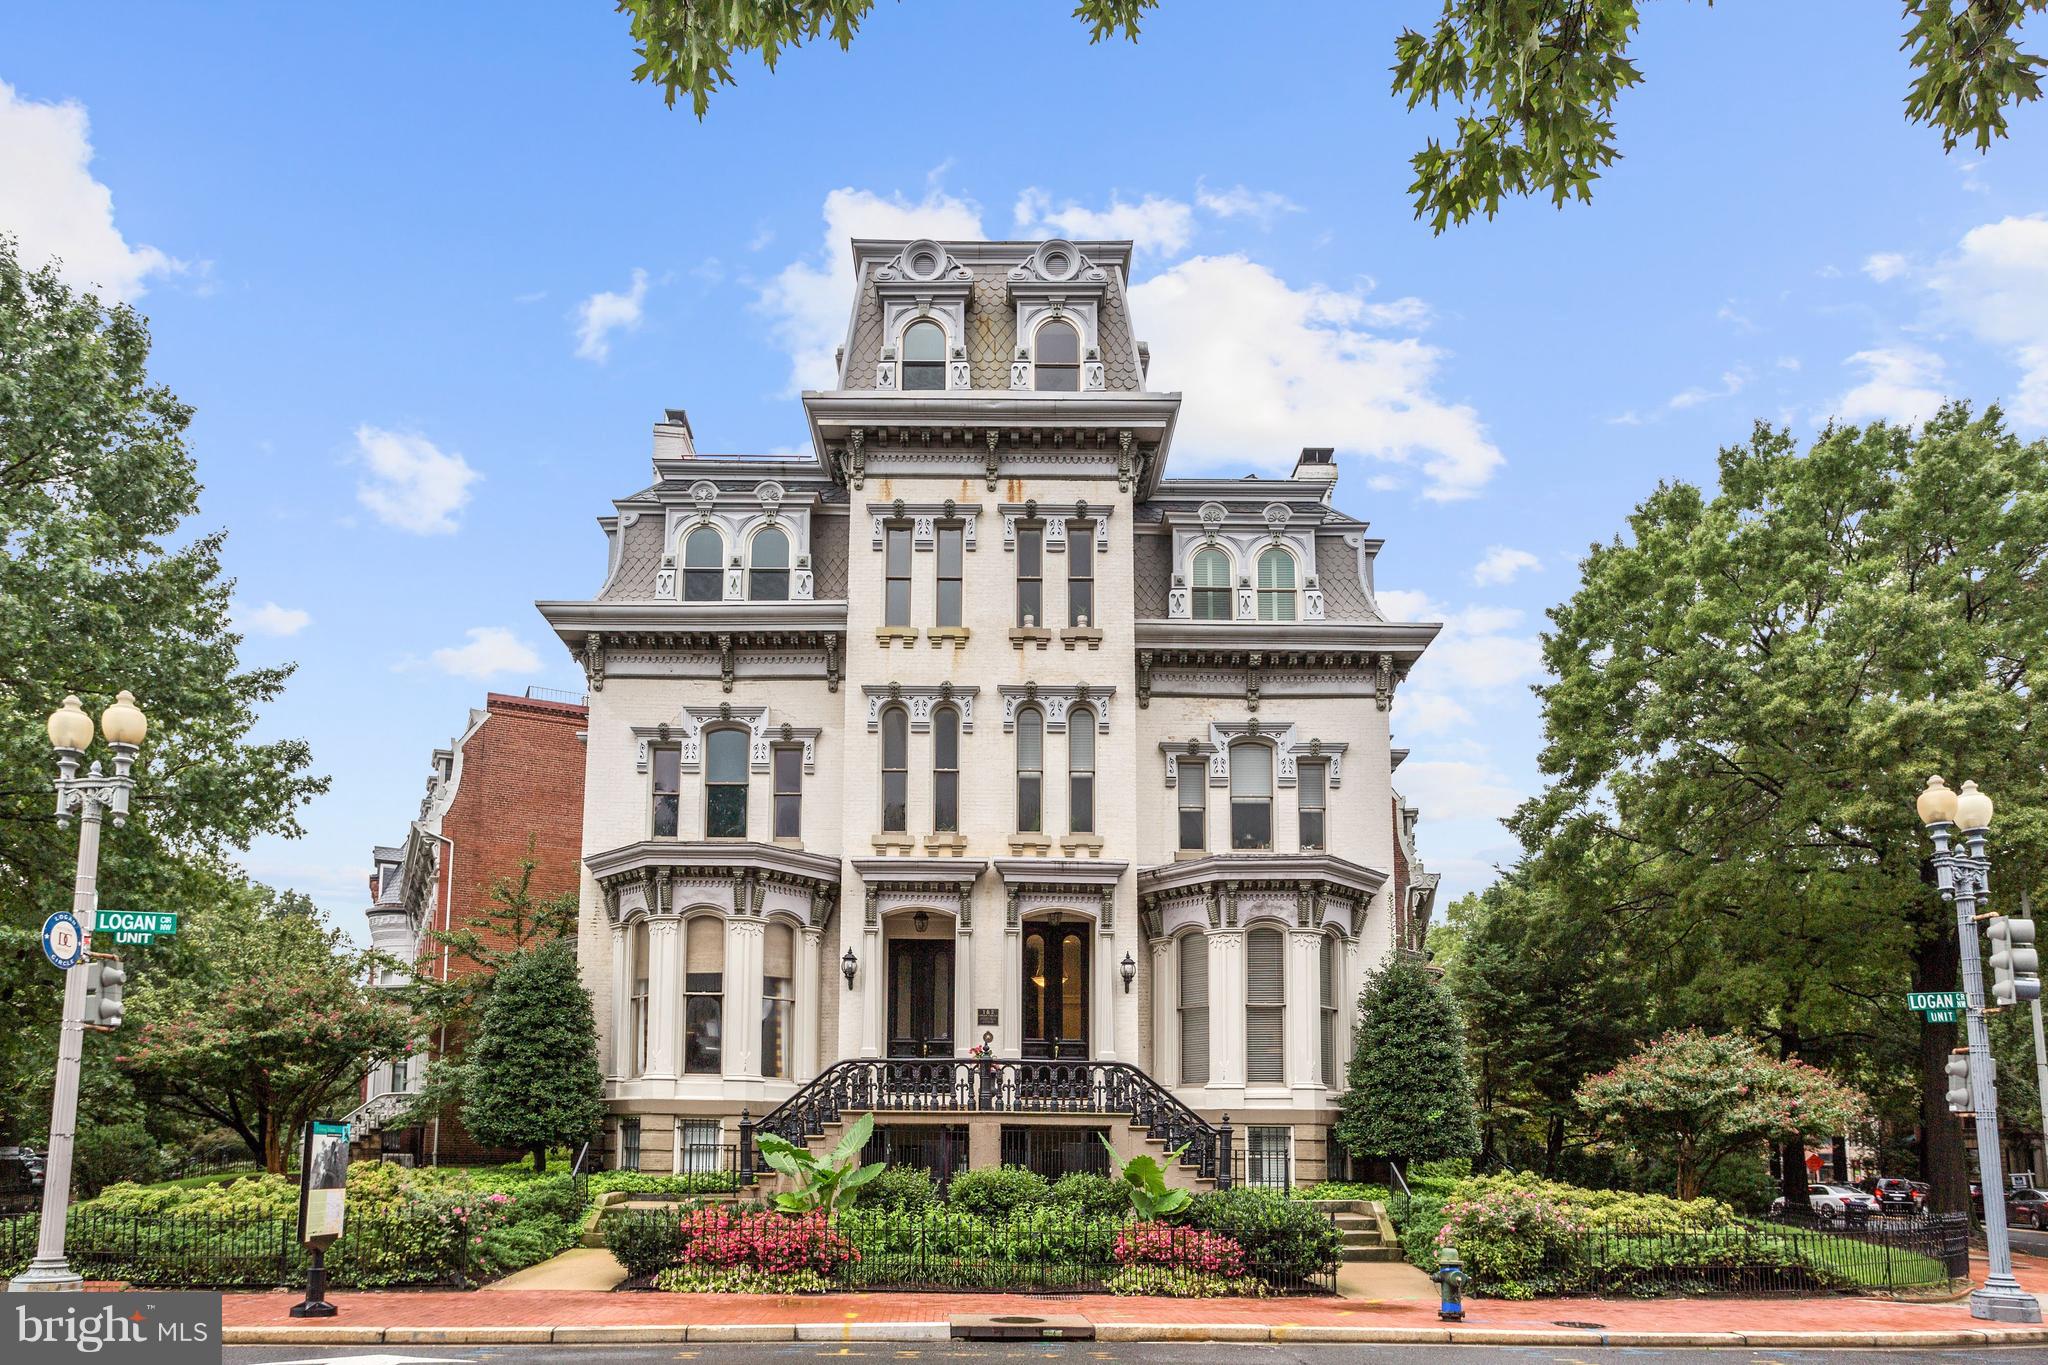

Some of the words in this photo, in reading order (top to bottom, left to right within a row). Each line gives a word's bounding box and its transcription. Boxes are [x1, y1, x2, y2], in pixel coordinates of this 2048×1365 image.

[54, 914, 77, 926] LOGAN
[99, 913, 157, 931] LOGAN
[116, 931, 153, 944] UNIT
[51, 954, 75, 966] CIRCLE
[1909, 994, 1954, 1009] LOGAN
[1956, 1000, 1967, 1008] NW
[1930, 1011, 1953, 1022] UNIT
